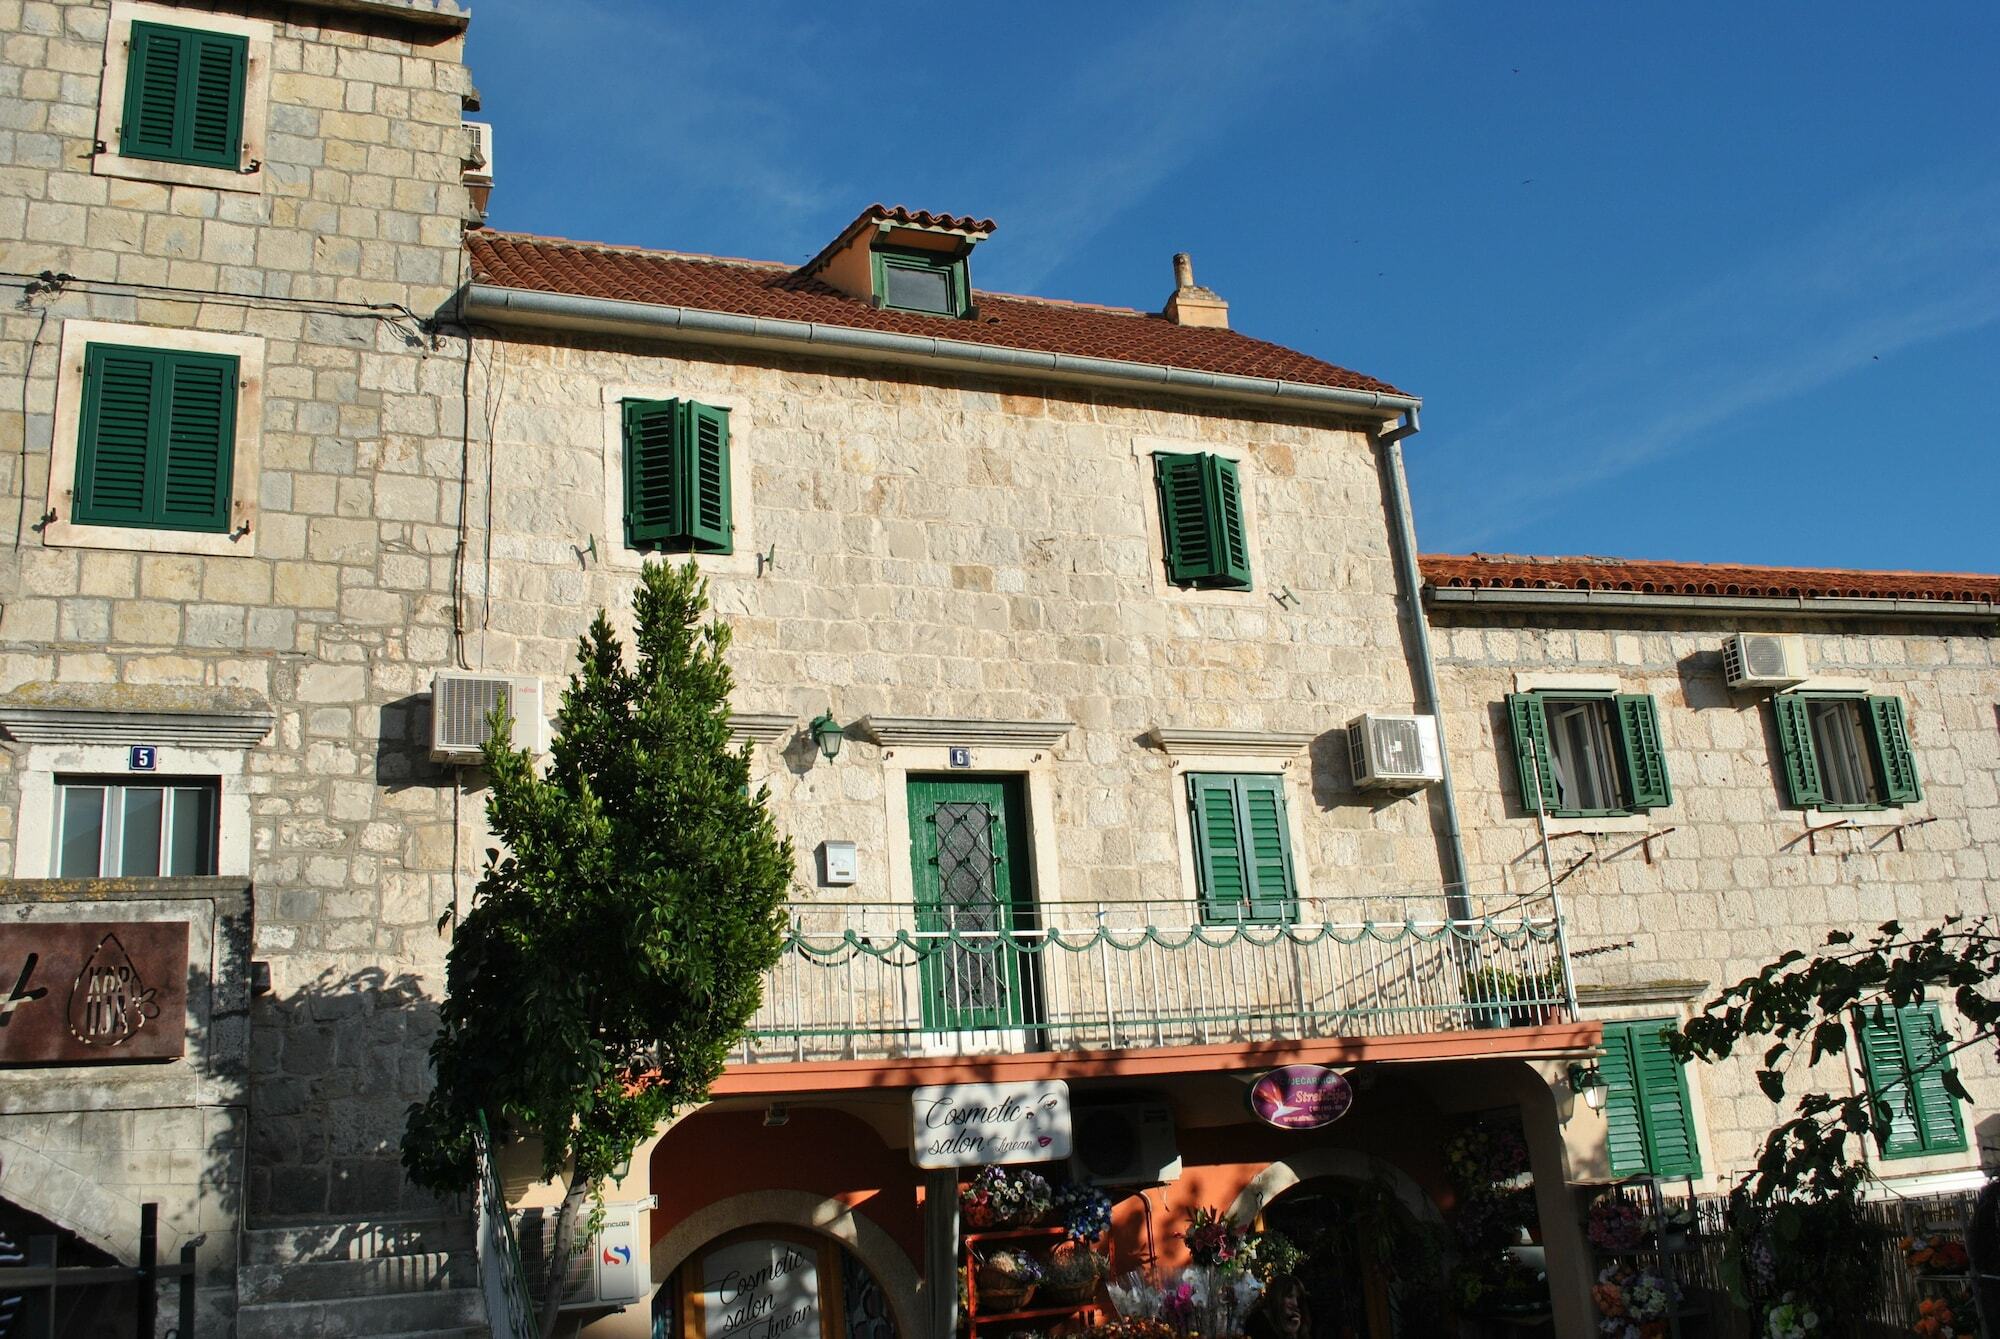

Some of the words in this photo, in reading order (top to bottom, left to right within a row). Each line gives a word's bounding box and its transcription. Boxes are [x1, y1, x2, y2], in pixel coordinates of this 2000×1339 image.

[139, 749, 149, 767] 5
[956, 750, 964, 765] 6
[914, 1095, 1023, 1130] Cosmetic
[927, 1128, 985, 1156] salon
[704, 1246, 806, 1305] Cosmetic
[722, 1291, 778, 1332] salon
